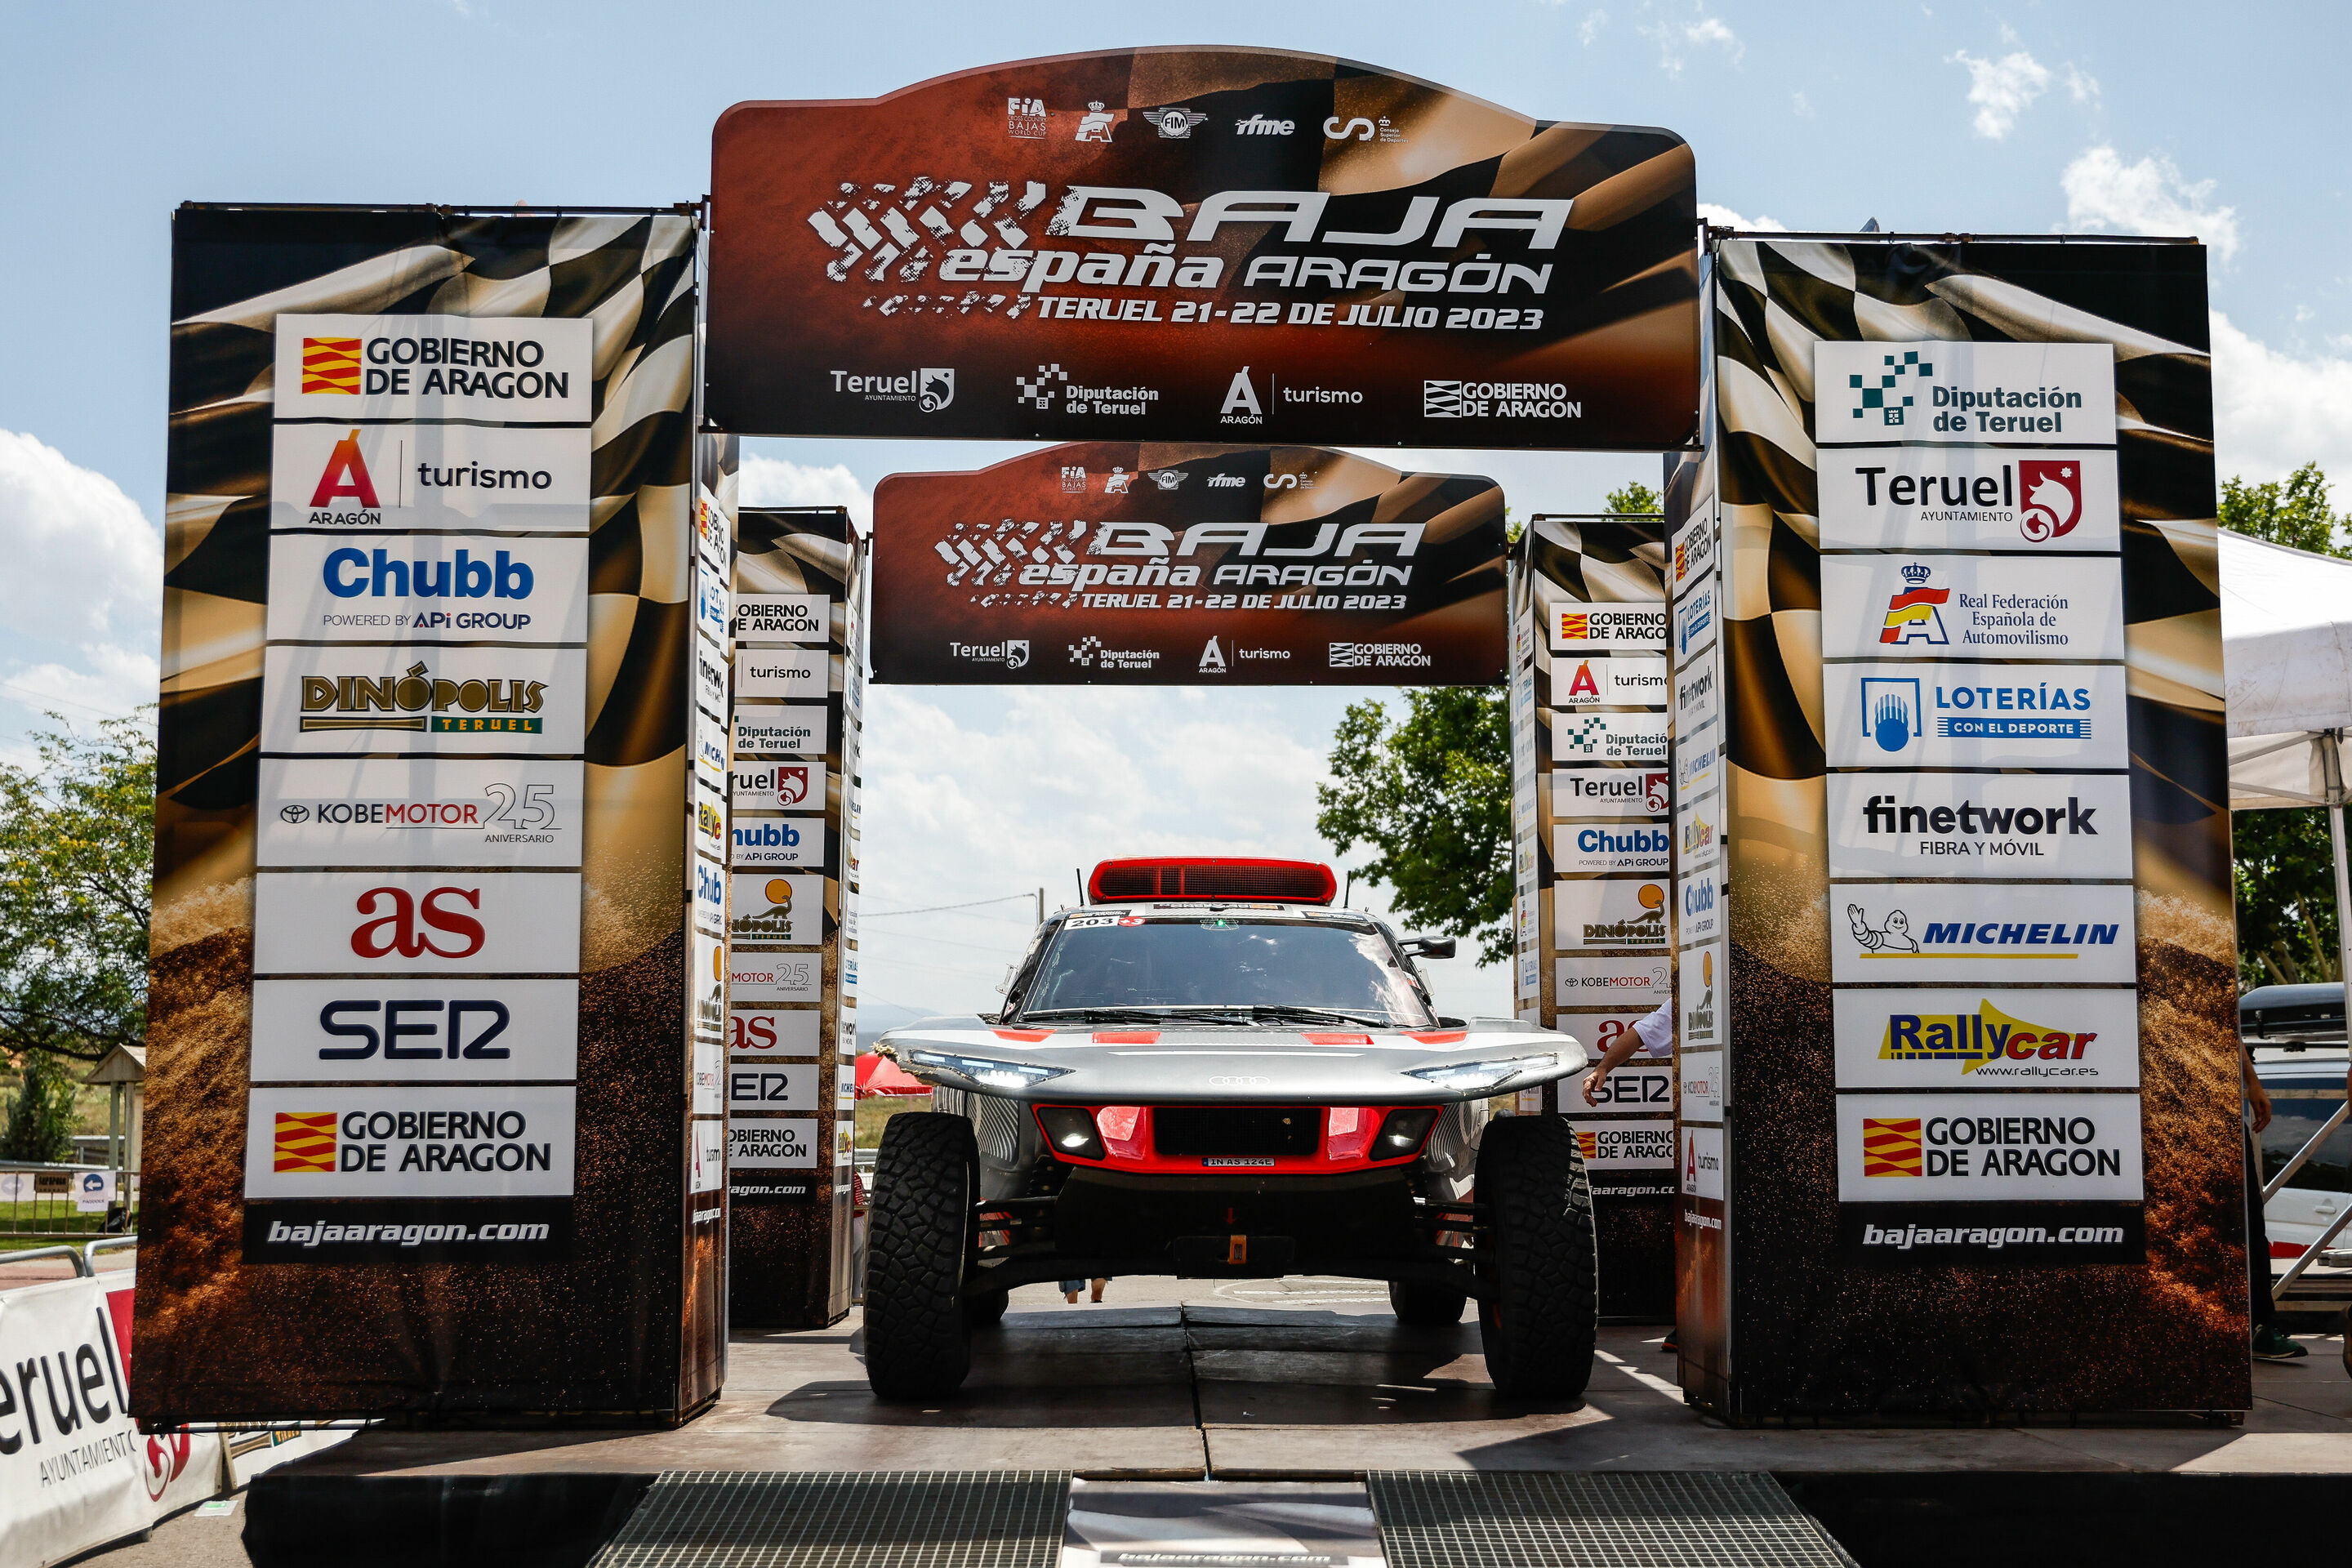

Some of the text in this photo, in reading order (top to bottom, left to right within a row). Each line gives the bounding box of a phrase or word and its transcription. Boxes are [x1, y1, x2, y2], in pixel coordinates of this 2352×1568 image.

[1009, 121, 1046, 131] BAJAS
[1165, 117, 1184, 129] FIM
[1045, 185, 1574, 249] BAJA
[939, 243, 1553, 294] españa ARAGÓN
[1038, 296, 1544, 330] TERUEL 21-22 DE JULIO 2023
[367, 337, 544, 368] GOBIERNO
[366, 369, 568, 399] DE ARAGON
[831, 370, 916, 394] Teruel
[1463, 382, 1567, 400] GOBIERNO
[1067, 385, 1158, 402] Diputación
[1283, 386, 1363, 403] turismo
[1932, 385, 2082, 412] Diputación
[1067, 401, 1146, 415] de Teruel
[1463, 401, 1581, 418] DE ARAGON
[1220, 415, 1263, 424] ARAGÓN
[1934, 412, 2062, 433] de Teruel
[418, 461, 552, 489] turismo
[1855, 465, 2012, 506] Teruel
[309, 510, 381, 524] ARAGÓN
[1920, 511, 2012, 522] AYUNTAMIENTO
[1086, 522, 1426, 556] BAJA
[323, 547, 534, 599] Chubb
[1019, 557, 1413, 592] españa ARAGÓN
[736, 604, 808, 617] OBIERNO
[1082, 594, 1406, 609] TERUEL 21-22 DE JULIO 2023
[1960, 594, 2069, 610] Real Federación
[323, 615, 390, 626] POWERED
[396, 615, 411, 626] BY
[457, 612, 531, 630] GROUP
[752, 618, 819, 631] ARAGON
[1589, 612, 1666, 626] GOBIERNO
[1972, 612, 2056, 630] Española de
[1589, 627, 1666, 639] DE ARAGO
[1962, 630, 2069, 645] Automovilismo
[950, 642, 1004, 657] Teruel
[1100, 649, 1160, 660] Diputación
[1239, 648, 1290, 659] turismo
[1354, 644, 1421, 654] GOBIERNO
[1101, 660, 1152, 669] de Teruel
[1354, 655, 1431, 666] DE ARAGON
[750, 666, 811, 679] turismo
[301, 661, 549, 713] DINÓPOLIS
[1936, 683, 2091, 710] LOTERÍAS
[443, 719, 532, 731] TERUEL
[738, 726, 811, 738] Diputación
[1953, 722, 2074, 734] CON EL DEPORTE
[738, 738, 800, 749] de Teruel
[1606, 733, 1667, 746] Diputació
[1606, 746, 1666, 755] de Teruel
[1570, 777, 1643, 796] Teruel
[318, 783, 555, 829] KOBEMOTOR 25
[1863, 795, 2098, 835] finetwork
[485, 834, 554, 843] ANIVERSARIO
[1578, 829, 1669, 852] Chubb
[1920, 839, 2044, 856] FIBRA Y MÓVIL
[1636, 858, 1668, 866] GROUP
[350, 887, 485, 958] as
[1071, 918, 1113, 927] 203
[1584, 920, 1667, 938] DINÓPOLIS
[1922, 923, 2119, 945] MICHELIN
[732, 964, 809, 985] MOTOR 25
[1581, 967, 1671, 988] KOBEMOTOR 2
[319, 1000, 510, 1059] SER
[1890, 1013, 2097, 1060] Rallycar
[1976, 1067, 2098, 1077] www.rallycar.es
[732, 1073, 788, 1101] ER
[342, 1111, 526, 1139] GOBIERNO
[1926, 1116, 2095, 1144] GOBIERNO
[341, 1143, 550, 1172] DE ARAGON
[738, 1144, 806, 1157] ARAGON
[1598, 1146, 1618, 1158] DE
[1698, 1152, 1719, 1170] turismo
[1927, 1148, 2120, 1176] DE ARAGON
[267, 1221, 549, 1247] bajaaragon.com
[1863, 1223, 2123, 1250] bajaaragon.com
[0, 1307, 128, 1454] eruel
[1118, 1552, 1330, 1563] bajaaragon.com
